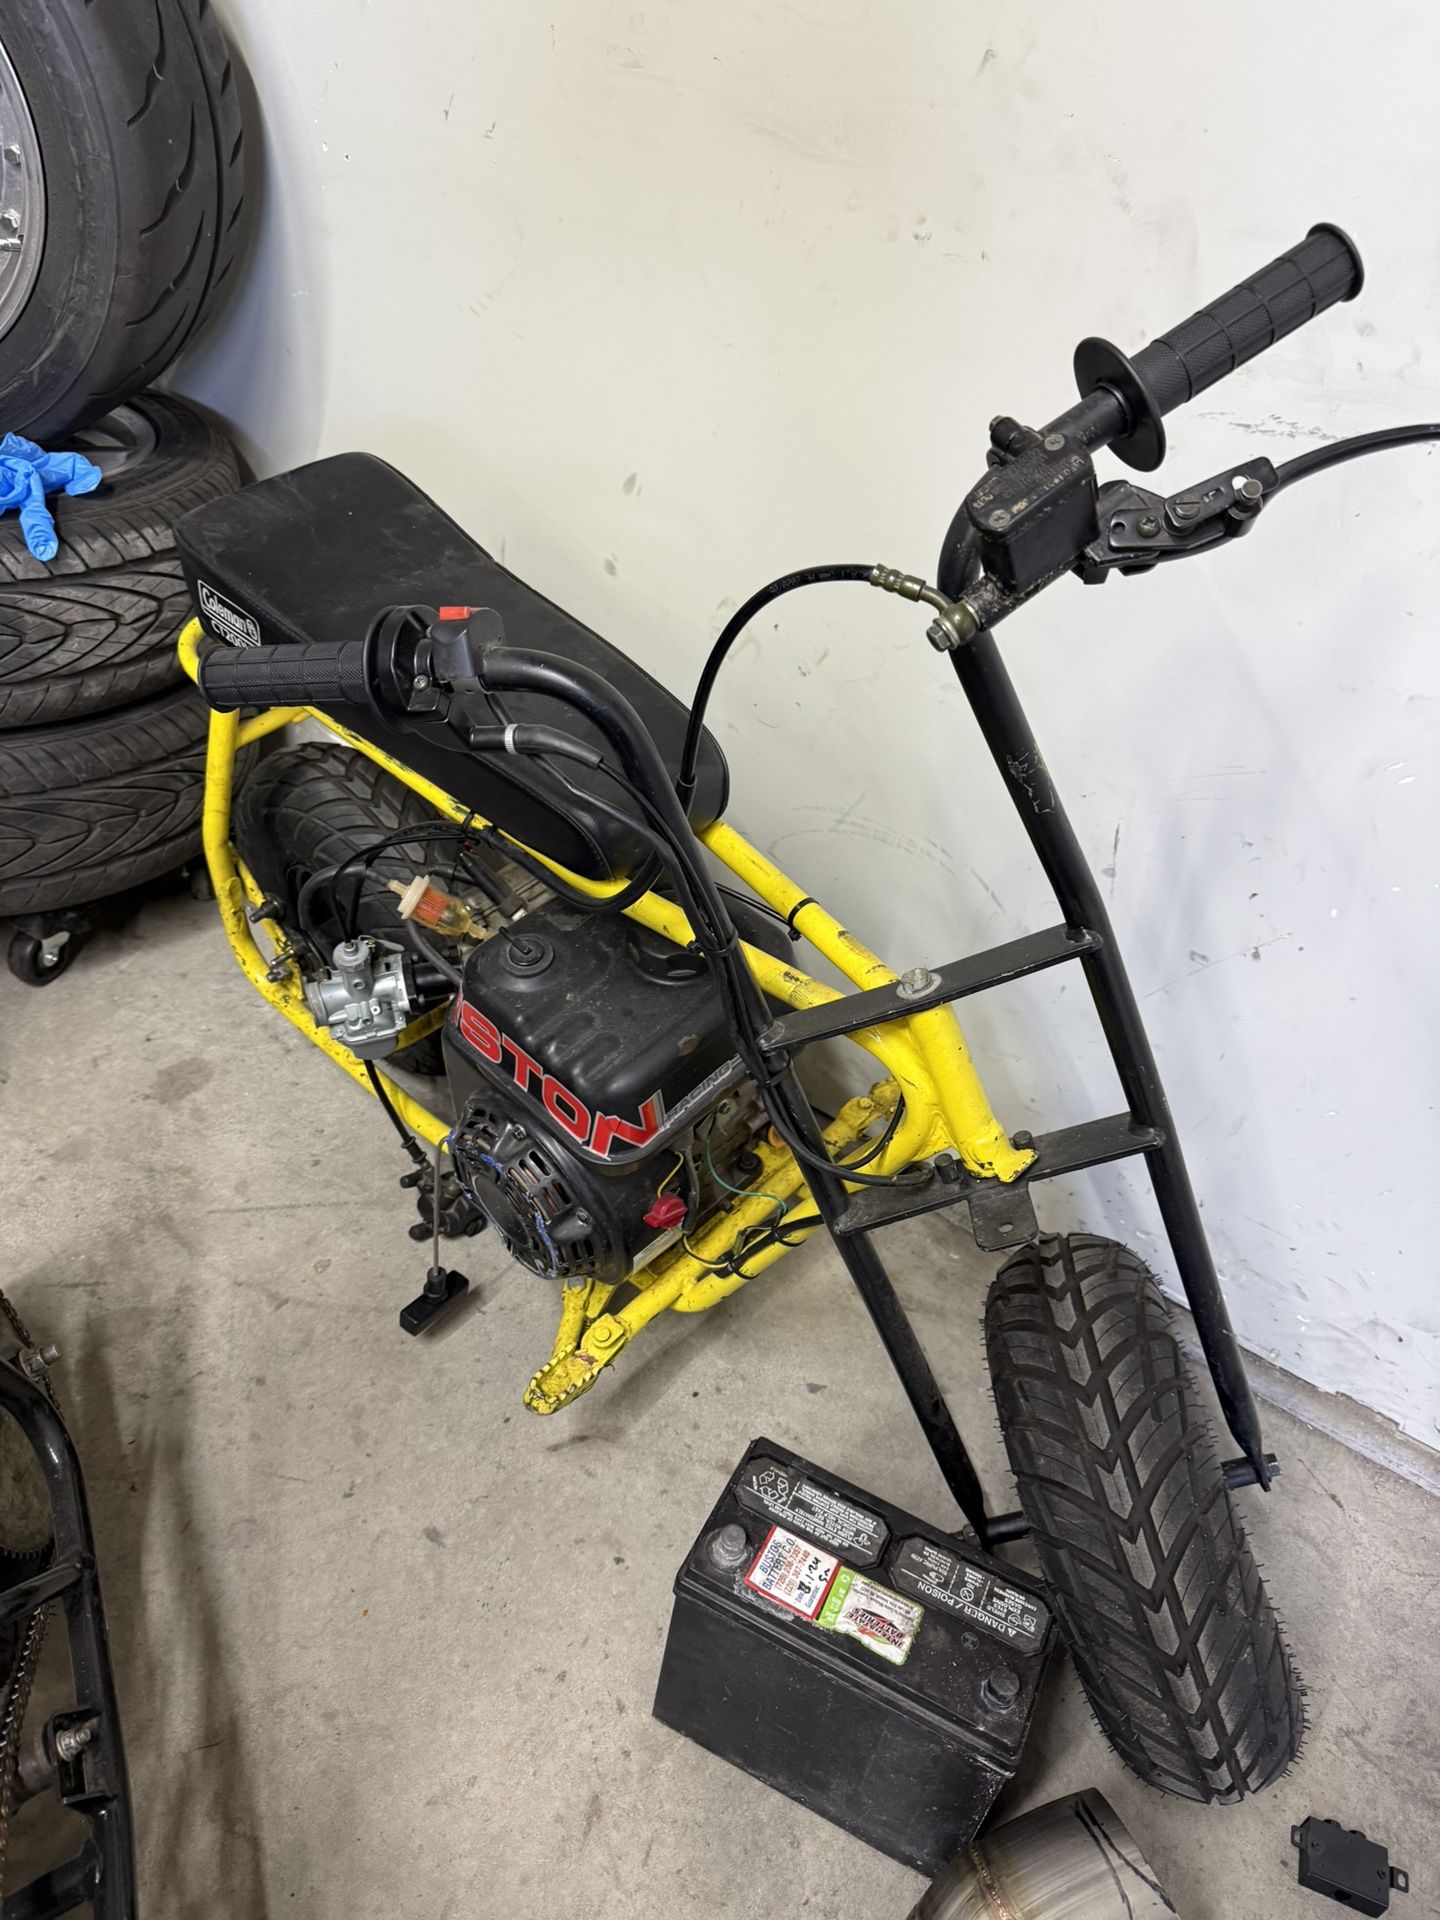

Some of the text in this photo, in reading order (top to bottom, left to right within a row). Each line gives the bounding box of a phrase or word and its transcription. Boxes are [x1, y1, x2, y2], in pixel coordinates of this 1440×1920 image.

[202, 587, 247, 633] Coleman
[455, 989, 665, 1158] STON
[795, 1508, 853, 1541] FLUSH EYES IMMEDIATELY
[811, 1506, 856, 1532] MEDICAL HELP FAST
[759, 1539, 782, 1574] BUSTOS
[762, 1552, 787, 1590] BATTERY
[917, 1581, 955, 1606] POISON
[955, 1601, 963, 1609] /
[843, 1610, 905, 1649] INTERSTATE
[850, 1608, 905, 1639] BATTERIES
[964, 1605, 1006, 1632] DANGER
